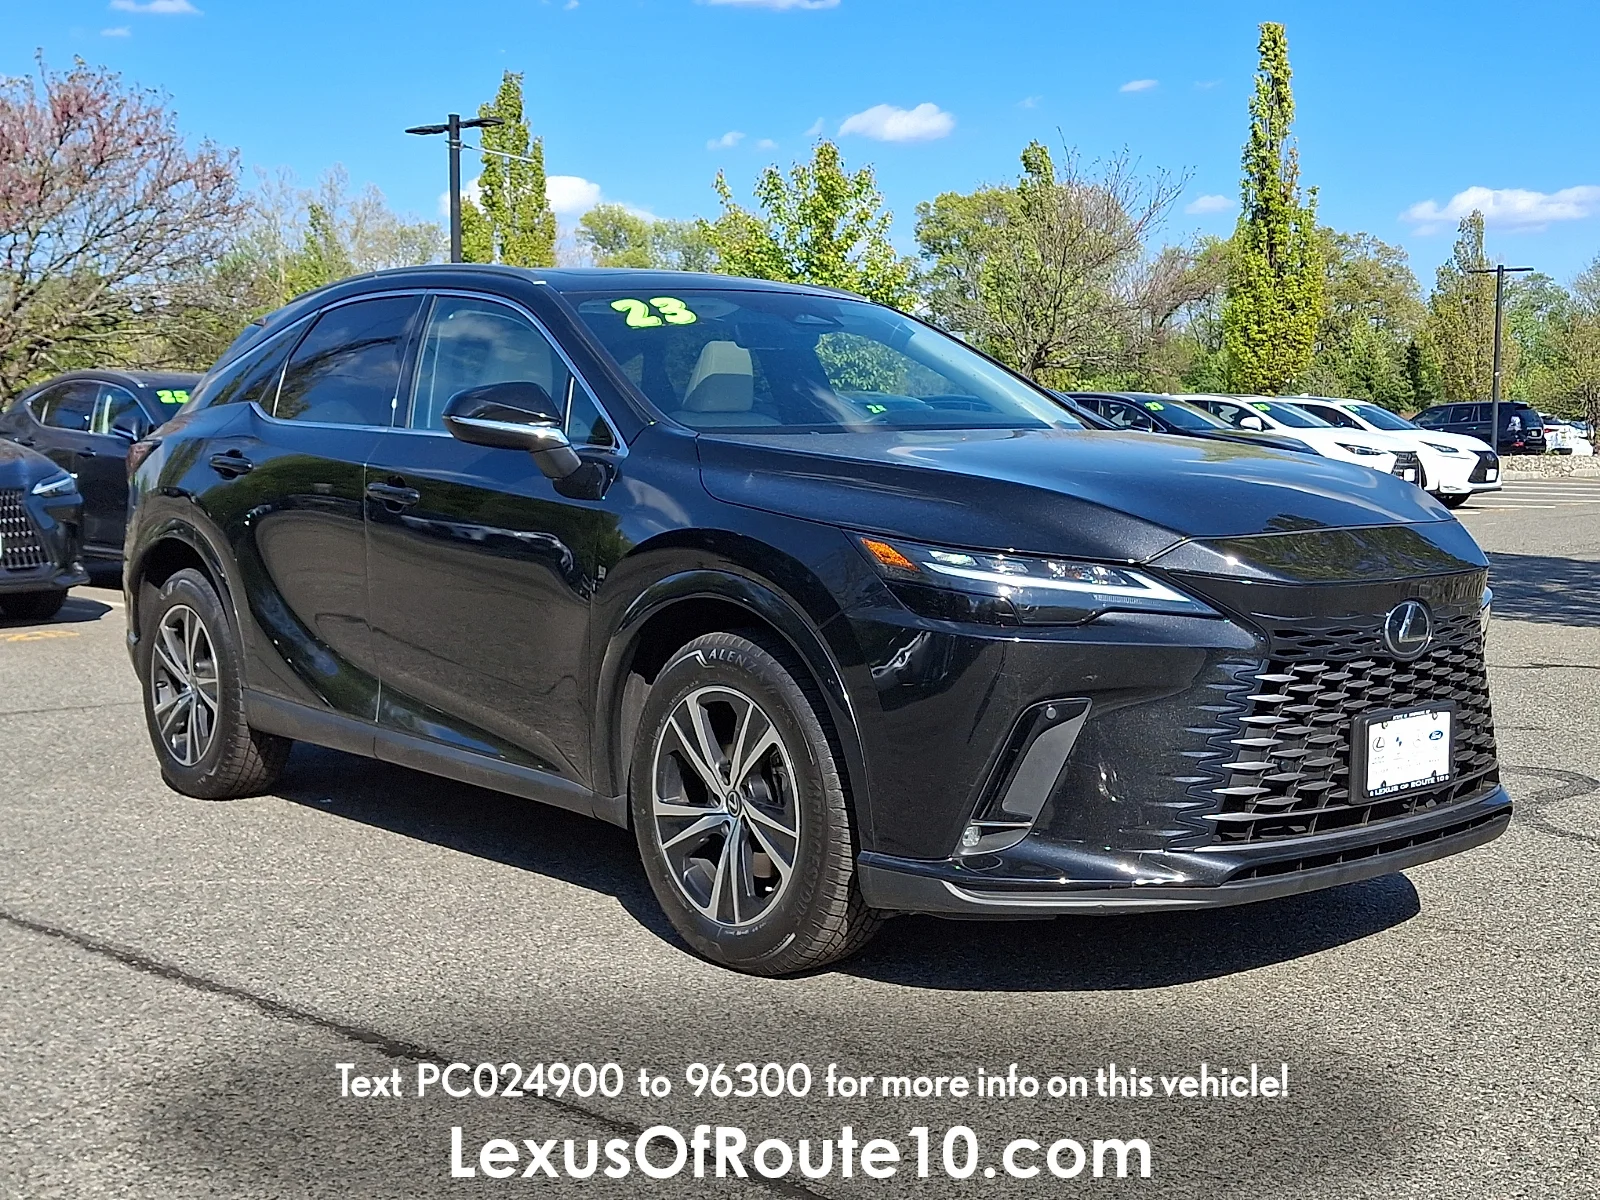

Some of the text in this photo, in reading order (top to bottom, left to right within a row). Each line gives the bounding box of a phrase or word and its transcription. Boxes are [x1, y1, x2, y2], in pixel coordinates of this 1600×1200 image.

[609, 296, 698, 329] 23
[156, 389, 190, 404] 25
[708, 648, 767, 682] ALENZA
[1374, 785, 1399, 796] LEXUS
[1410, 776, 1436, 788] ROUTE
